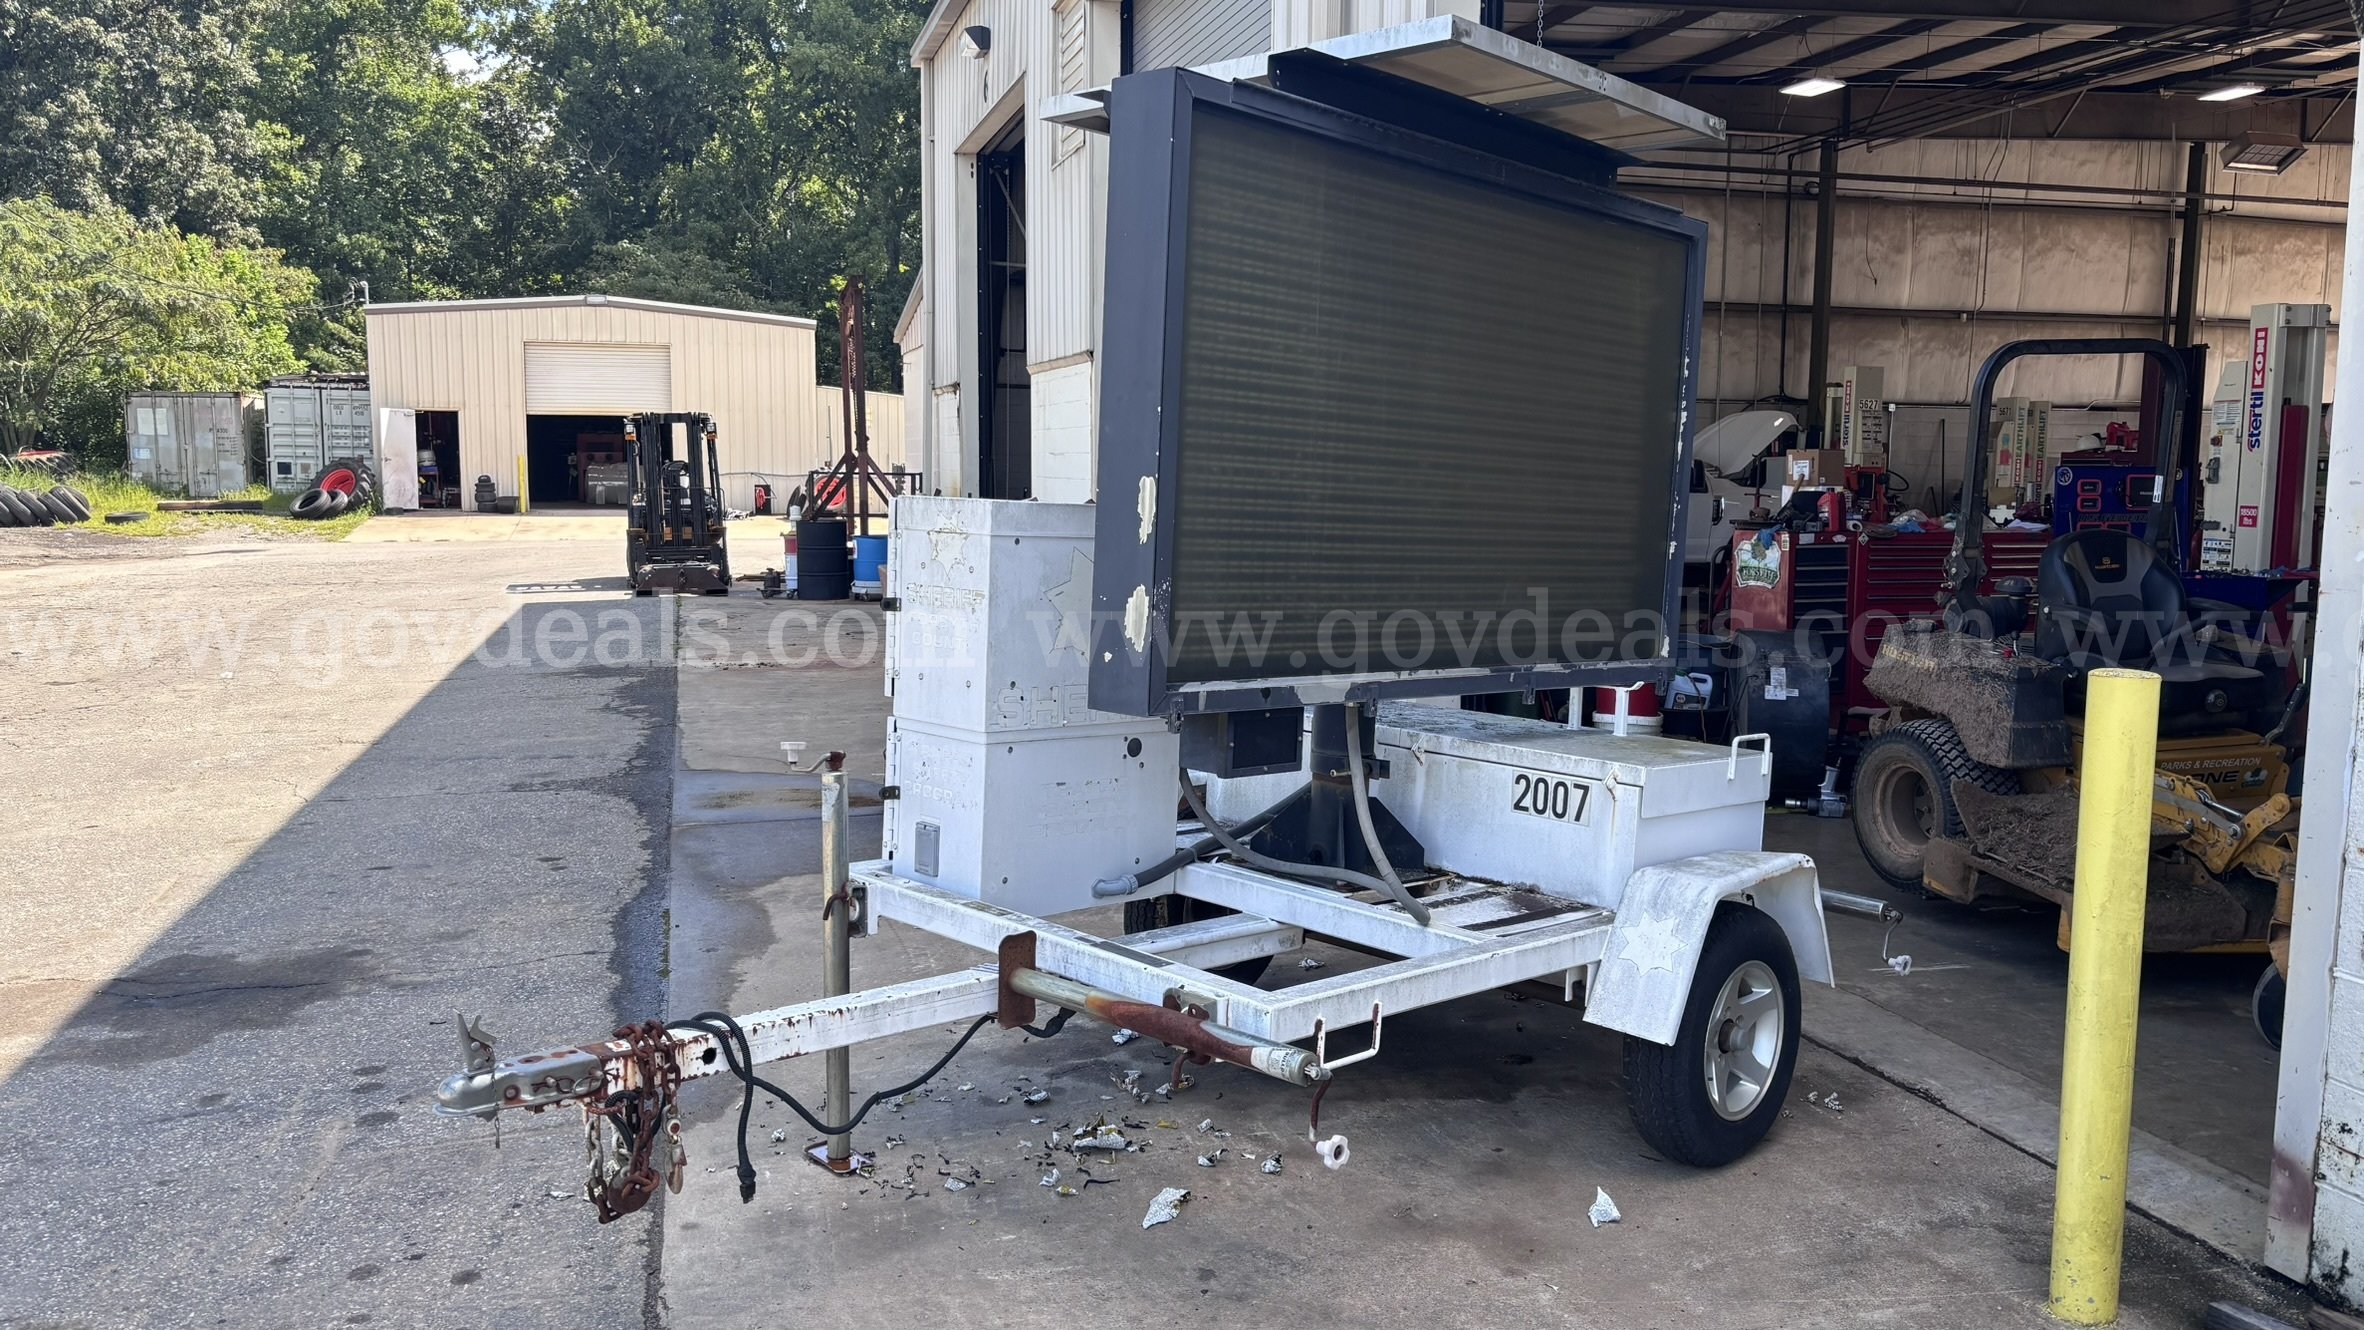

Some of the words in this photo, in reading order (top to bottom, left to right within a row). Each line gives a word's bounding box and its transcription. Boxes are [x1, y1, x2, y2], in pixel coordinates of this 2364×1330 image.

[2254, 331, 2265, 386] KONI
[1859, 400, 1878, 409] 5627
[2249, 391, 2264, 451] stertil
[2015, 407, 2025, 457] EARTHLIFT
[2037, 410, 2046, 459] EARTHLIFT
[2160, 761, 2192, 770] PARKS
[2194, 759, 2200, 769] &
[2202, 757, 2261, 769] RECREATION
[1513, 773, 1590, 822] 2007
